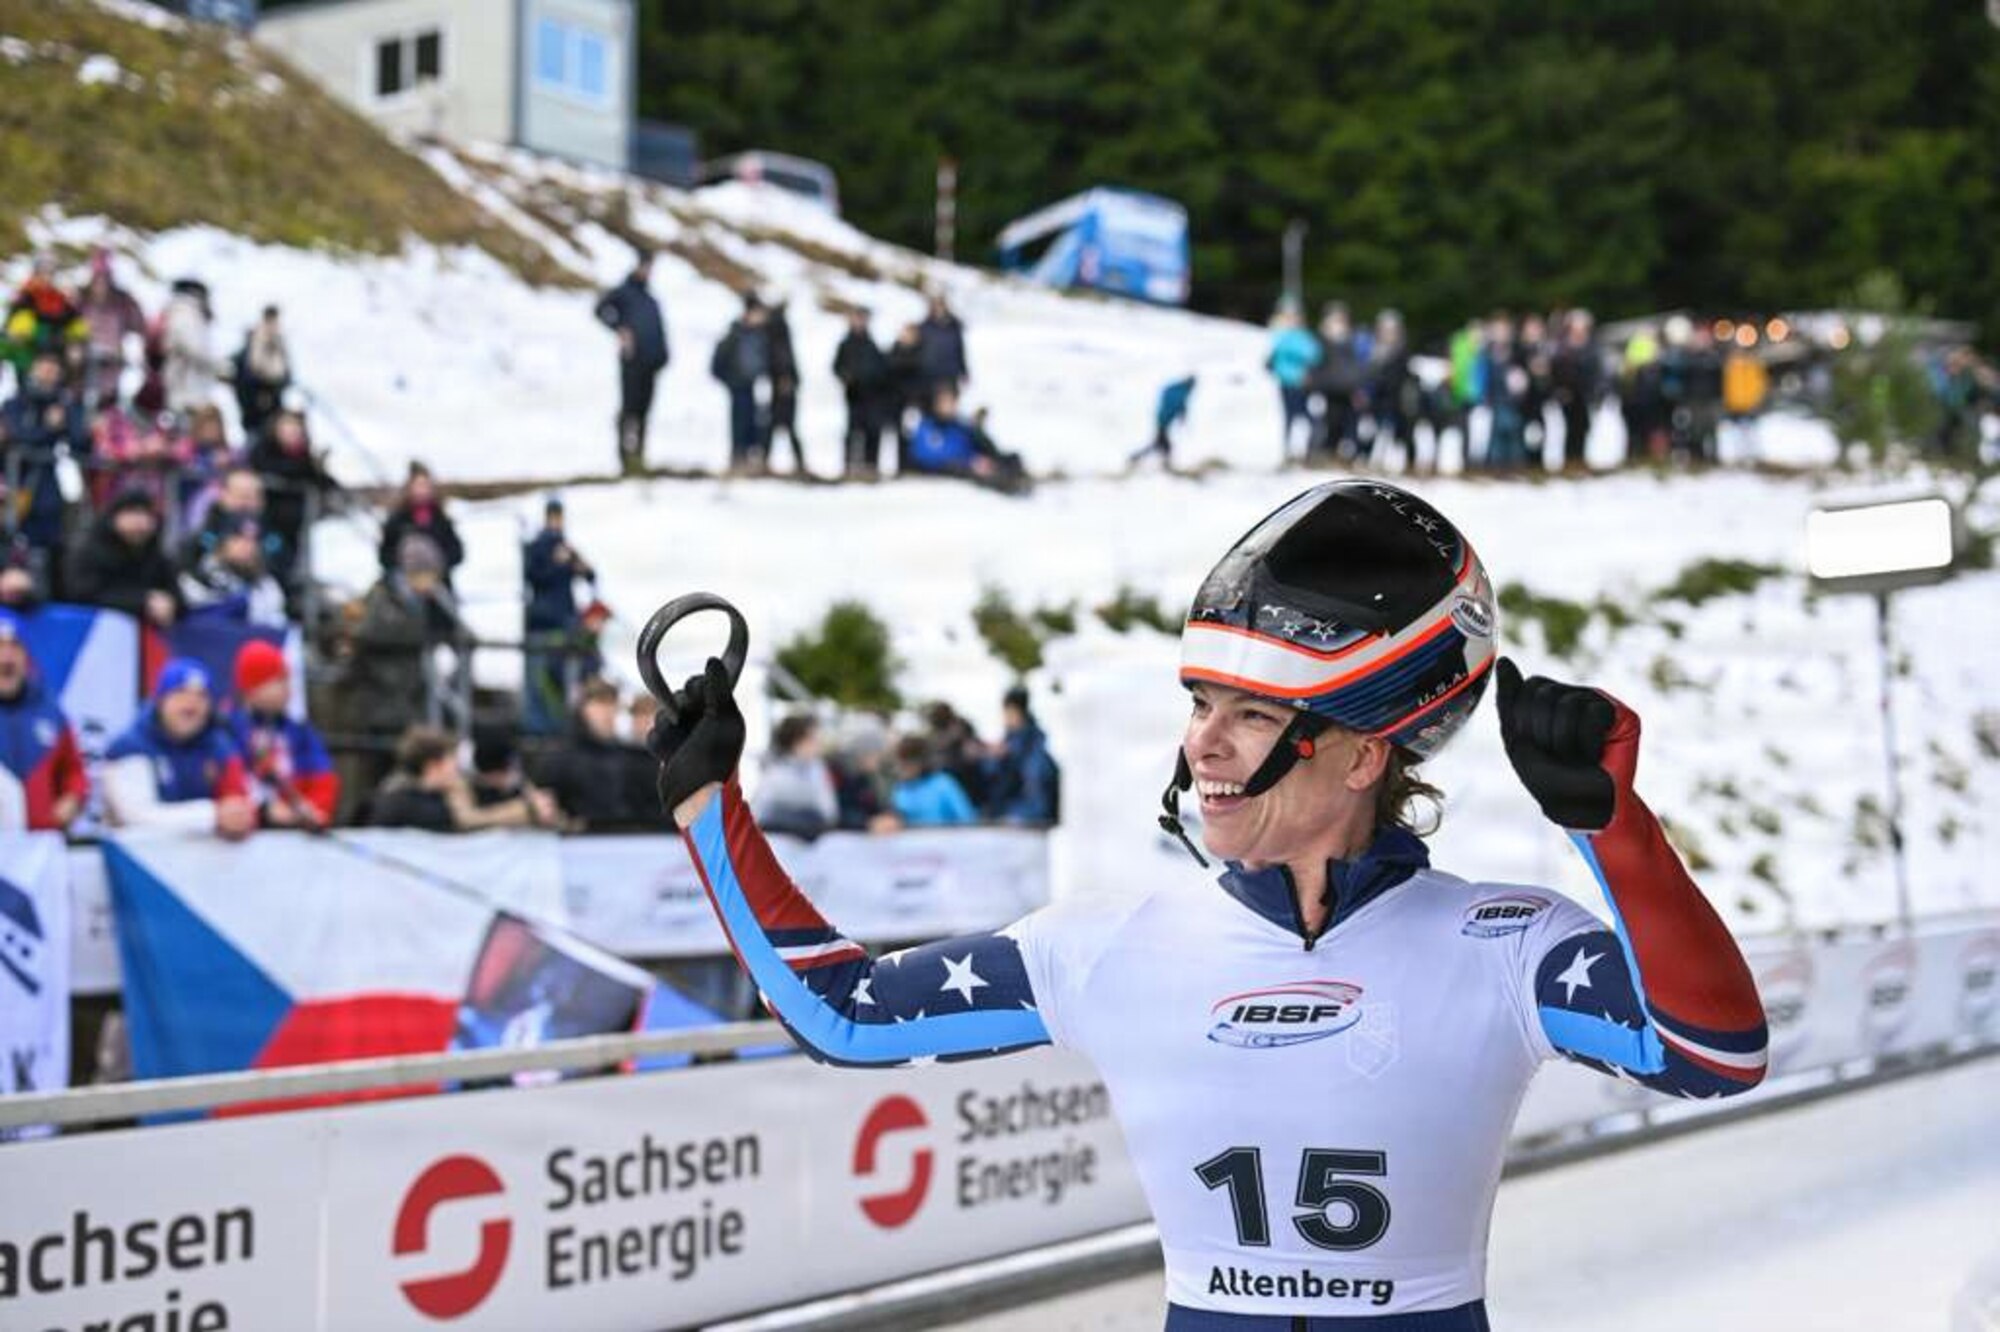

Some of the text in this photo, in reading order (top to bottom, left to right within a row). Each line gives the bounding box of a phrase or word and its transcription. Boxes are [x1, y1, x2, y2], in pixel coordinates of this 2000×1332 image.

[1474, 905, 1536, 920] IBSF
[1231, 1004, 1342, 1023] IBSF
[957, 1080, 1109, 1143] Sachsen
[546, 1134, 760, 1211] Sachsen
[958, 1137, 1096, 1207] Energie
[1194, 1146, 1392, 1252] 15
[547, 1200, 744, 1290] Energie
[1208, 1265, 1395, 1306] Altenberg
